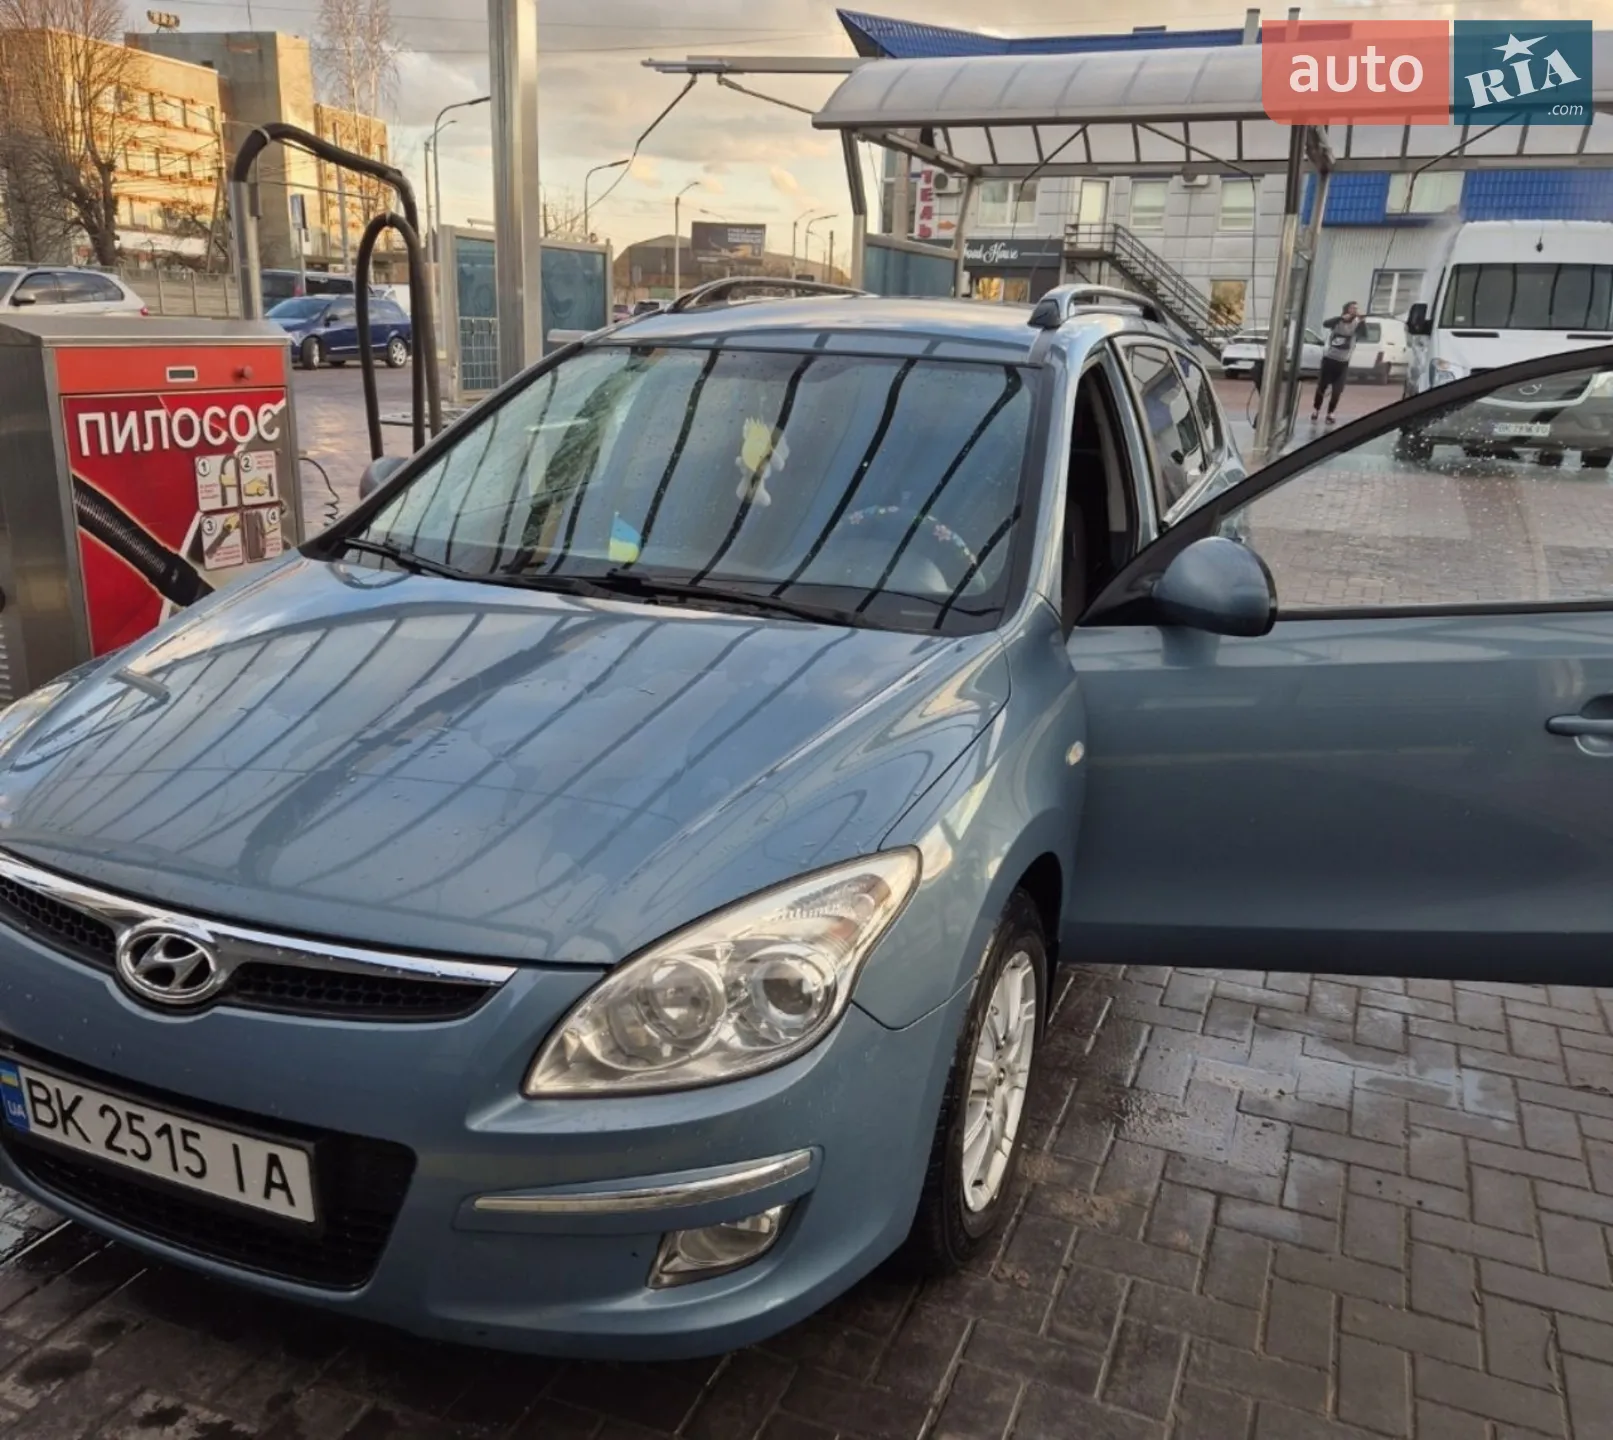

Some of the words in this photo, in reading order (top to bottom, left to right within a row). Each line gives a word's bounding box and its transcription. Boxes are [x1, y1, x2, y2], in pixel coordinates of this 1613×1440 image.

[919, 169, 934, 239] ТЕЛЬ
[983, 241, 1019, 263] House
[77, 403, 280, 456] ПИЛОСОС
[7, 1101, 26, 1120] UA
[25, 1077, 91, 1144] BK
[99, 1104, 208, 1179] 2515
[232, 1143, 296, 1207] IA
